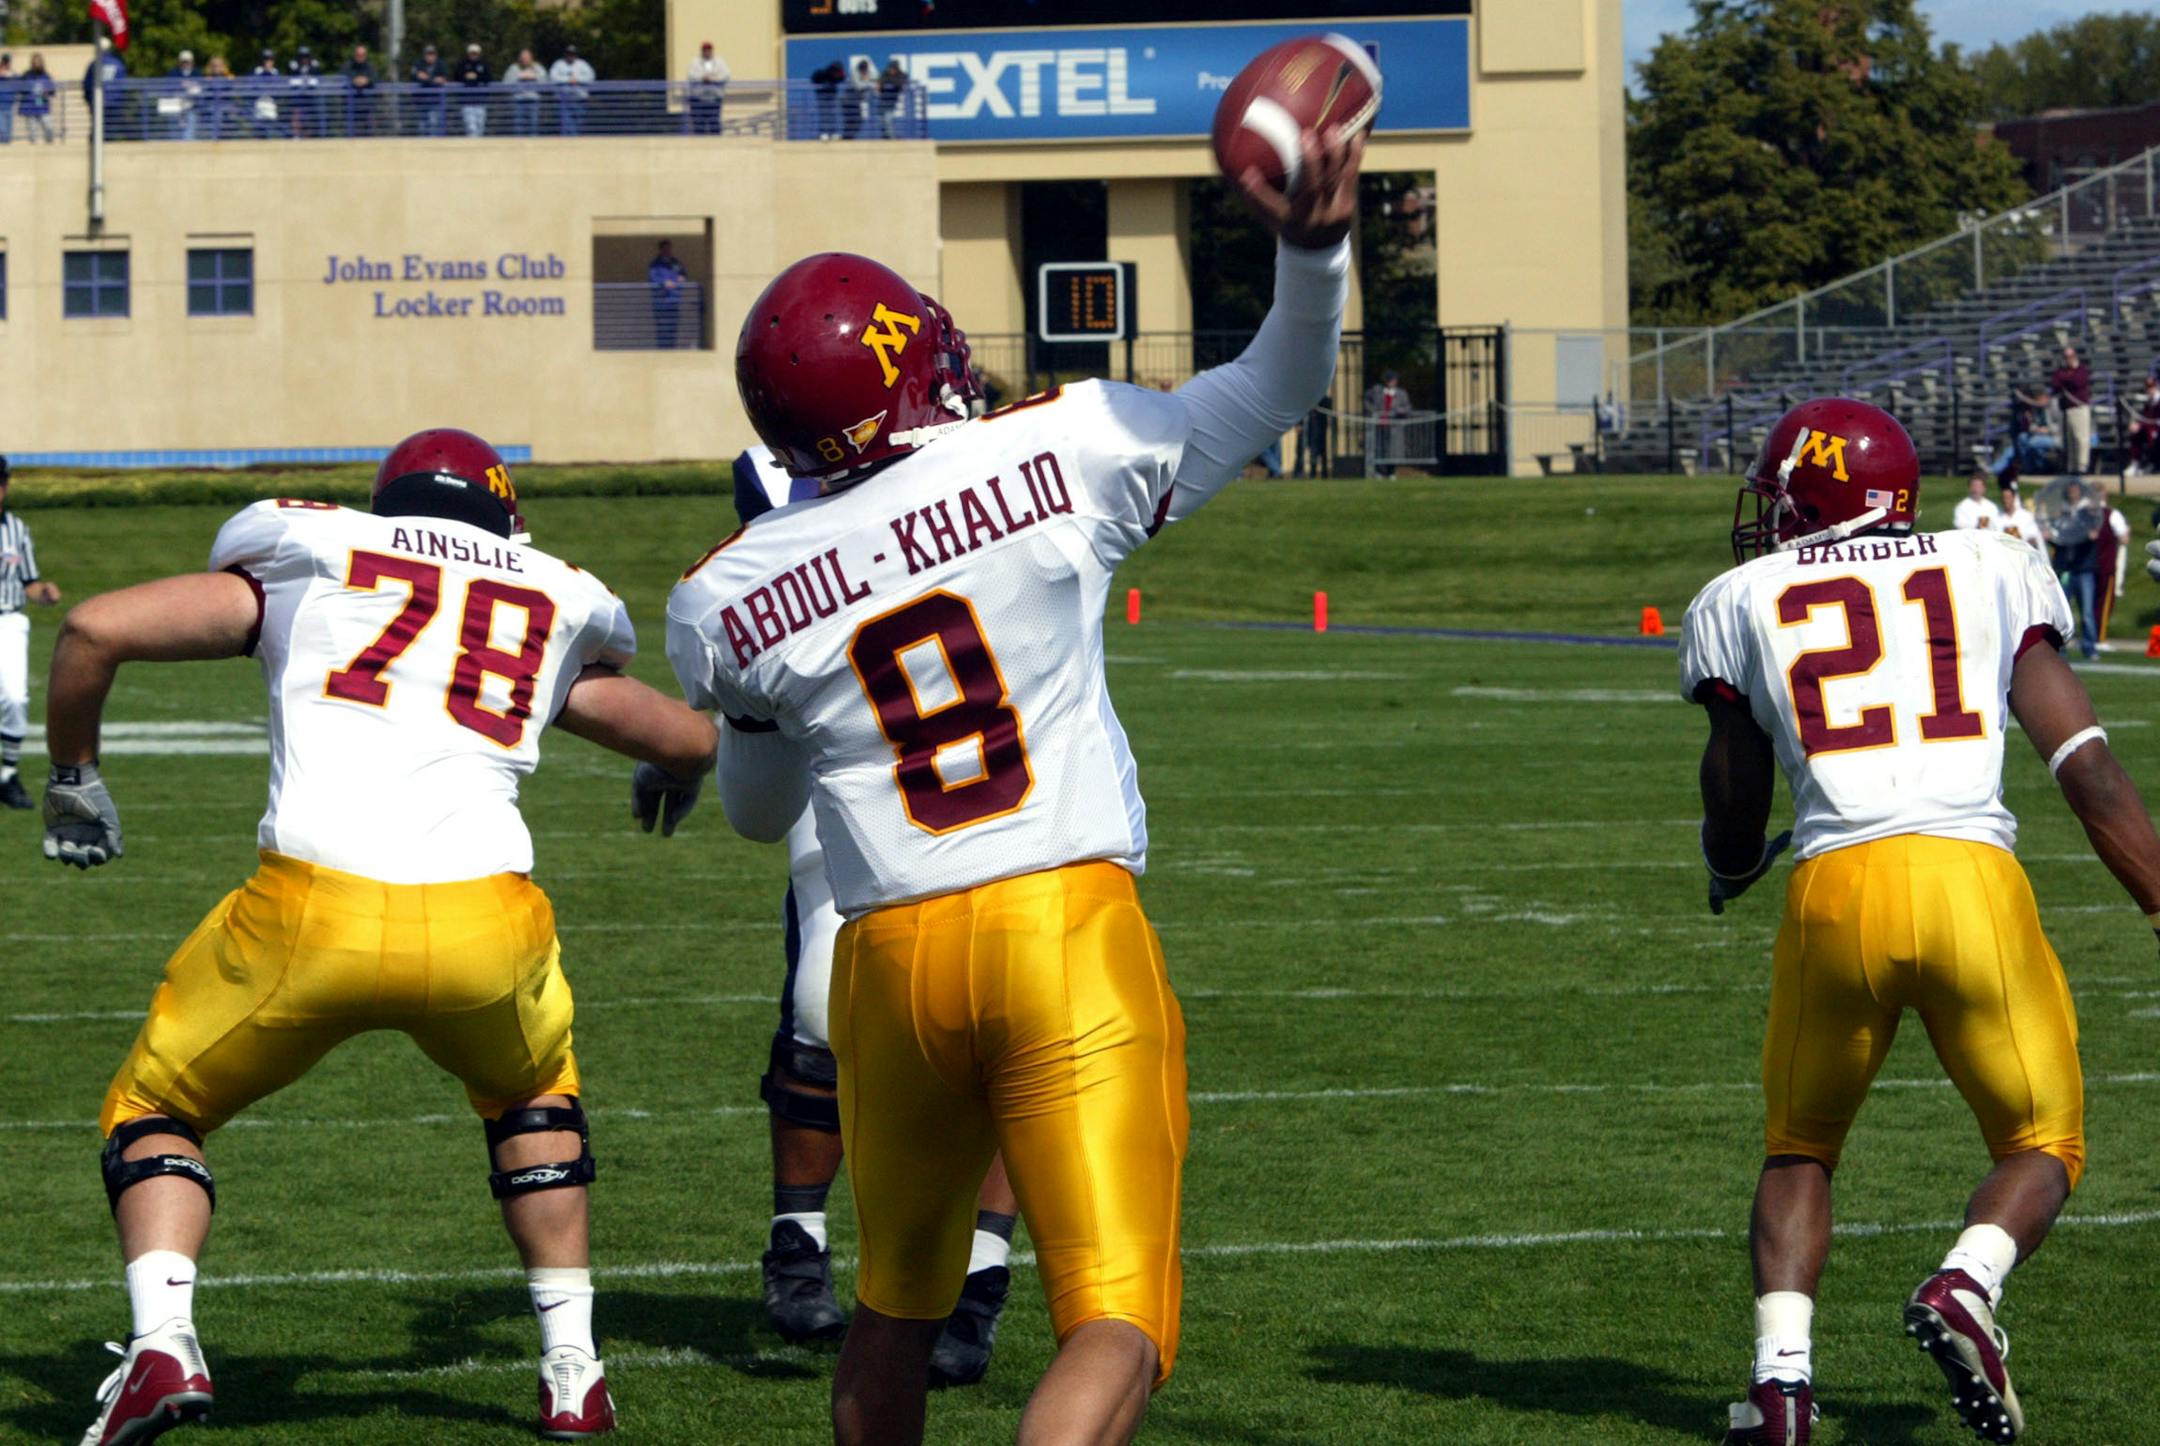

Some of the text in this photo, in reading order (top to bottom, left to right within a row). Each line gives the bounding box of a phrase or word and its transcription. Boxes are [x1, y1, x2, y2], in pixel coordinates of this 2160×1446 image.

[323, 253, 565, 284] John Evans Club
[374, 290, 565, 318] Locker Room
[1071, 275, 1114, 329] 10
[817, 437, 844, 462] 8
[1795, 430, 1850, 482] M
[391, 527, 524, 573] AINSLIE
[322, 546, 560, 751] 78
[1773, 565, 1988, 759] 21
[845, 586, 1036, 837] 8
